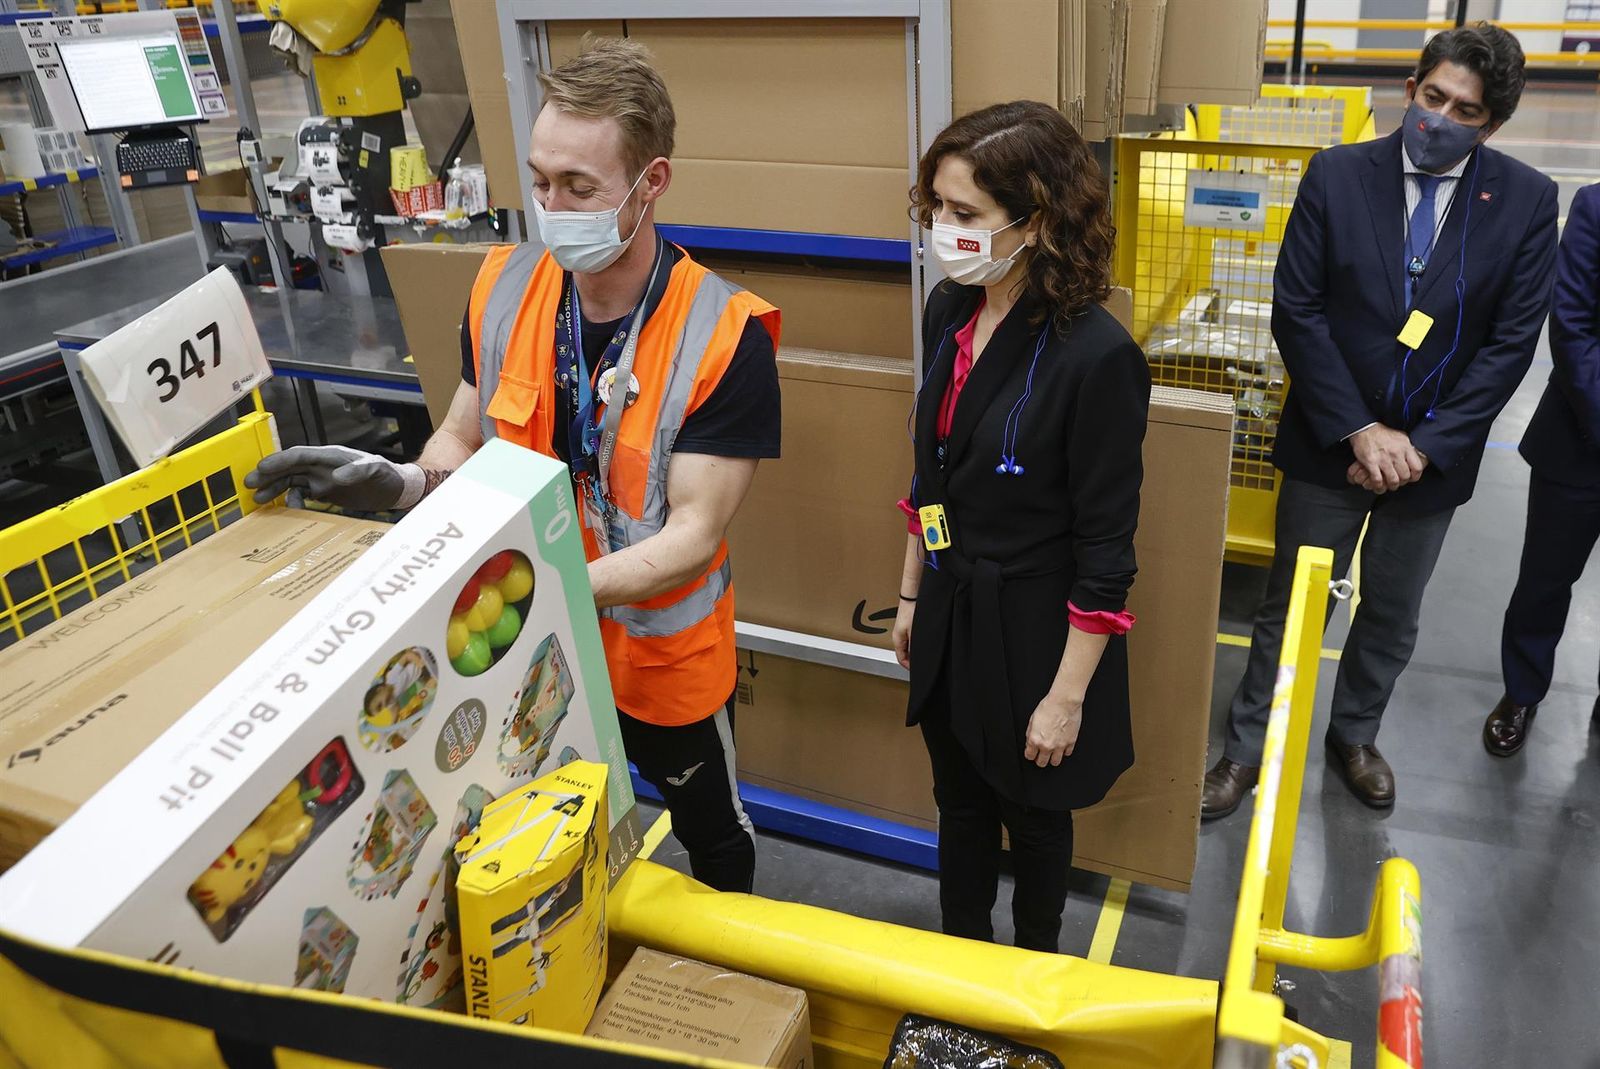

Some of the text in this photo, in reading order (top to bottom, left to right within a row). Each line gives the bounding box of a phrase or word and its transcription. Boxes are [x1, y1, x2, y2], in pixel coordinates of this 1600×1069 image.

[147, 321, 221, 403] 347
[370, 521, 465, 605] Activity
[27, 583, 158, 649] WELCOME
[305, 609, 376, 666] Gym
[275, 672, 309, 695] &
[45, 693, 129, 747] auna
[210, 700, 281, 762] Ball
[444, 724, 463, 769] 30 Balls
[464, 741, 475, 757] 4
[157, 765, 214, 811] Pit
[555, 774, 594, 791] STANLEY
[630, 981, 657, 993] Machine
[635, 973, 663, 985] Machine
[718, 997, 735, 1008] alloy
[683, 1032, 692, 1040] 18
[697, 1036, 707, 1044] 30
[707, 1040, 719, 1048] cm
